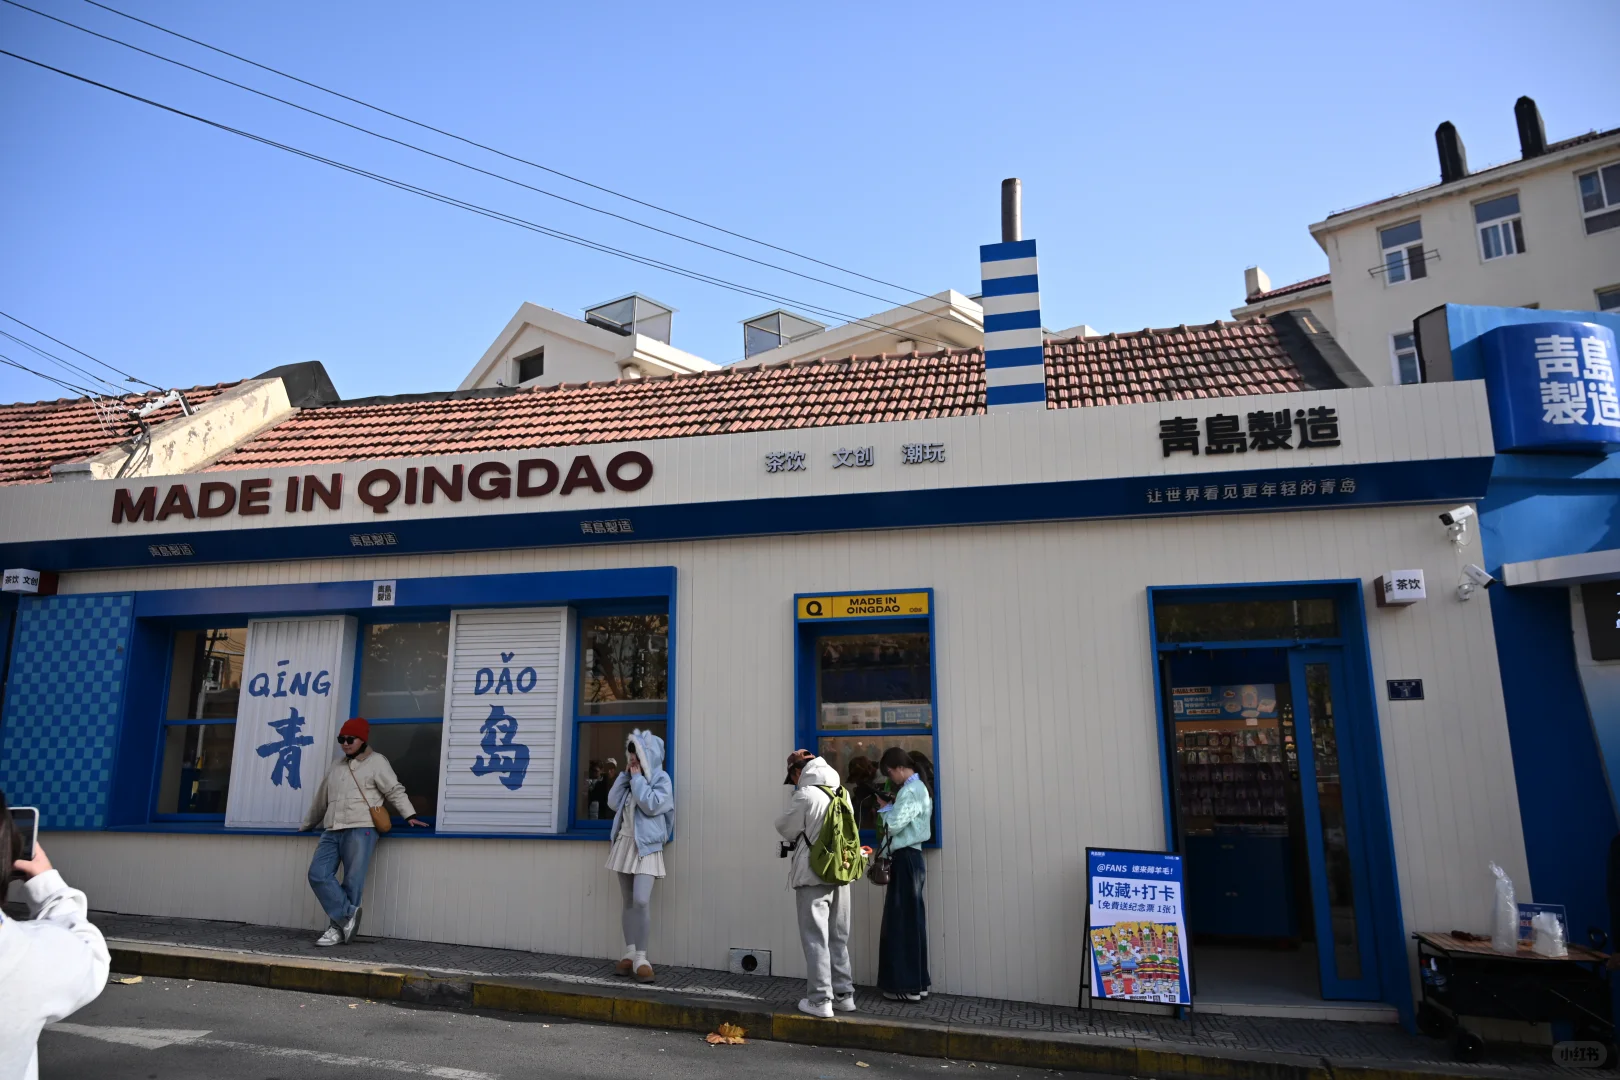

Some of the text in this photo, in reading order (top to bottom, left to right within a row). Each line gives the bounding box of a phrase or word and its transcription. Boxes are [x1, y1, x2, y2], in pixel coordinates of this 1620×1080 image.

[1535, 334, 1615, 383] 青島
[1540, 380, 1620, 427] 製造
[1159, 406, 1341, 457] 青島製造
[765, 442, 945, 473] 茶饮 文创 潮玩
[112, 450, 653, 524] MADE IN QINGDAO
[1147, 478, 1357, 503] 让世界看见更年轻的青岛
[23, 576, 38, 586] 文创
[1396, 579, 1421, 590] 茶饮
[806, 600, 823, 616] Q
[850, 598, 883, 606] MADE
[256, 706, 314, 790] 青
[469, 704, 530, 791] 岛
[1096, 863, 1128, 873] @FANS
[1098, 881, 1175, 901] 收藏+打卡
